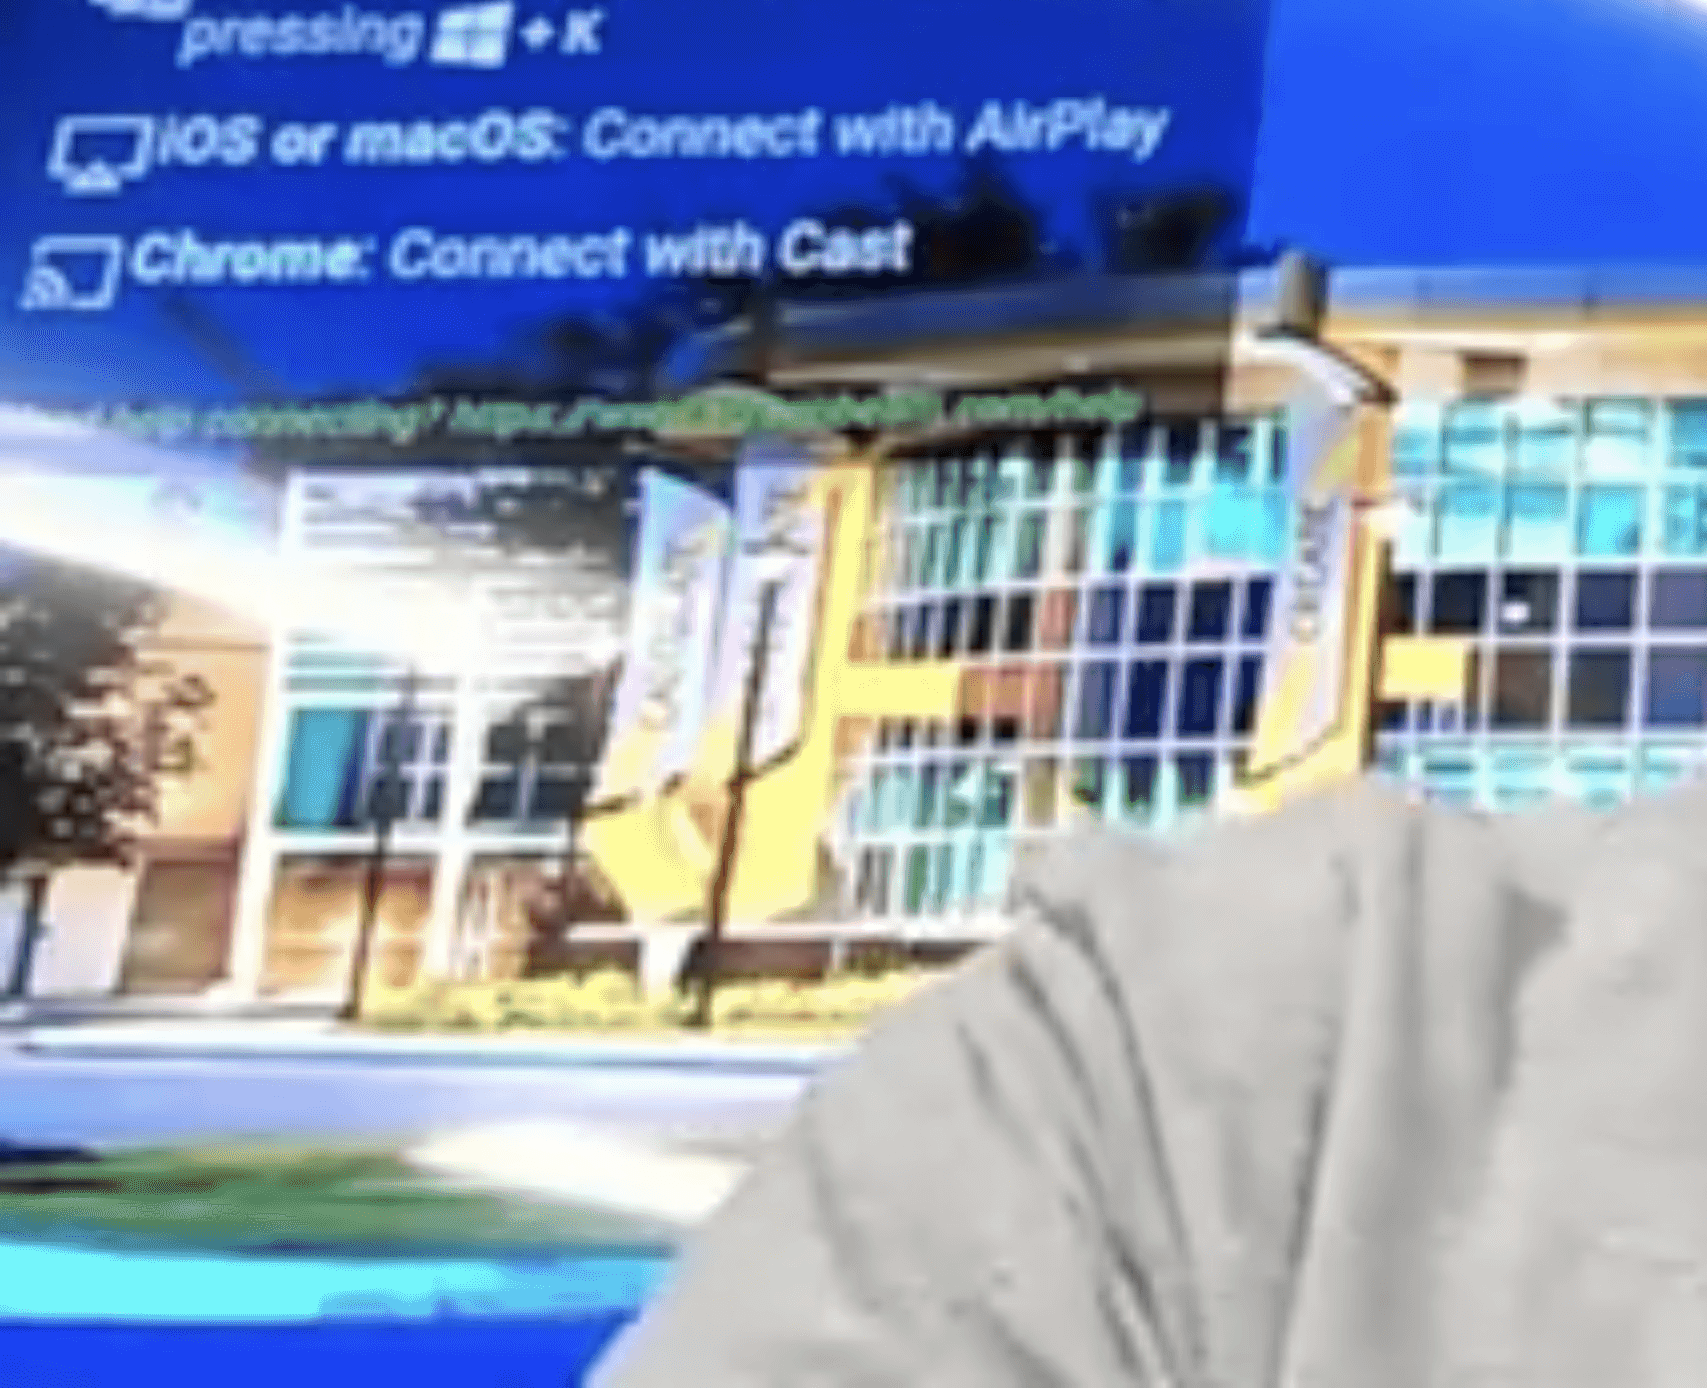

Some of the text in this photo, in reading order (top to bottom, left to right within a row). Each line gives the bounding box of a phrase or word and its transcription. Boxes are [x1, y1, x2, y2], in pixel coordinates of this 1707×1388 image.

[174, 5, 427, 70] pressing
[560, 7, 609, 55] K
[156, 92, 1172, 168] iOS or macOS: Connect with AirPlay
[129, 214, 914, 285] Chrome: Connect with Cast
